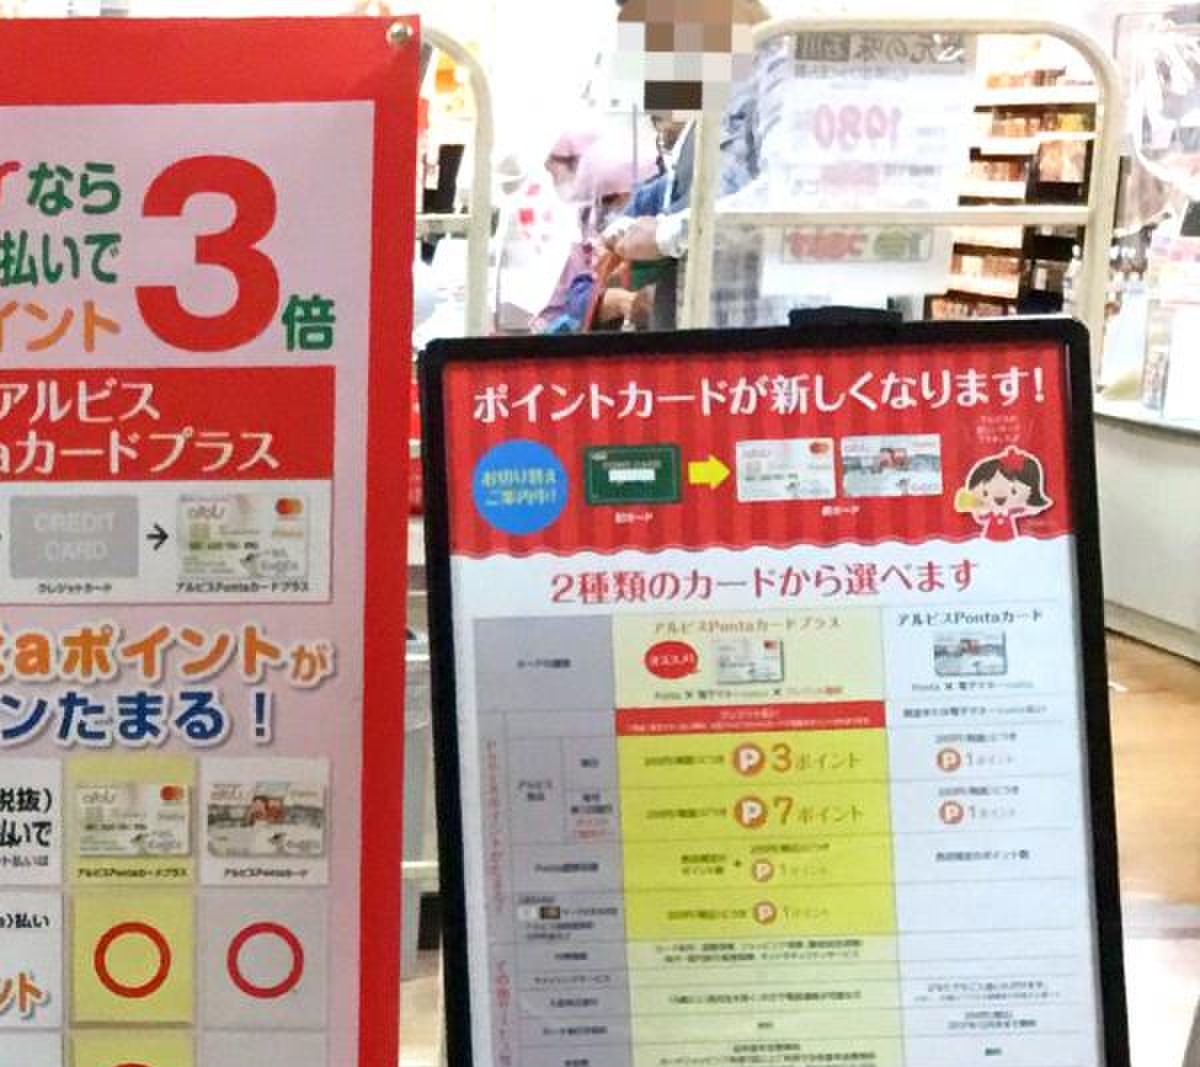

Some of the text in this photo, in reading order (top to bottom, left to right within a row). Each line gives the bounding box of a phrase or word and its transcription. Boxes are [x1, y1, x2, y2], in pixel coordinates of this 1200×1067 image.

[473, 367, 1046, 423] ポイントカードが新しくなります!
[551, 559, 978, 605] 2種類のカードから選べます
